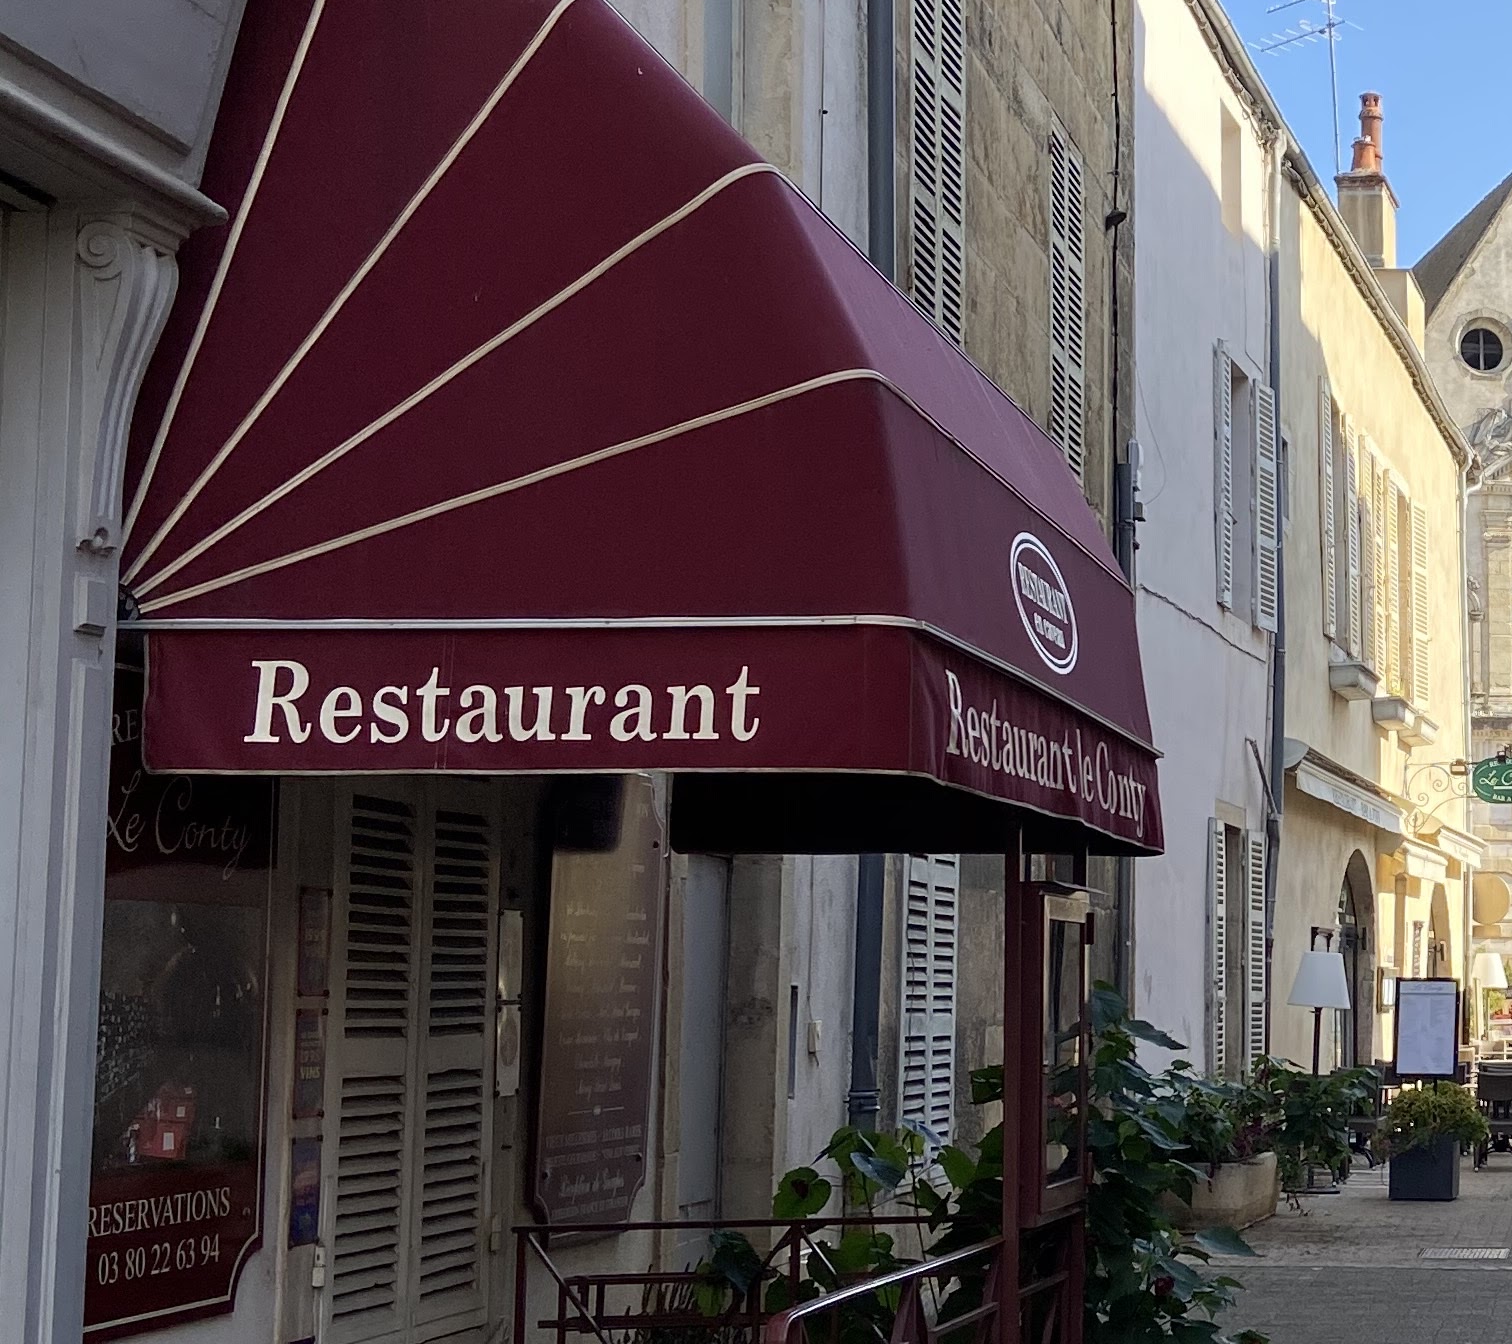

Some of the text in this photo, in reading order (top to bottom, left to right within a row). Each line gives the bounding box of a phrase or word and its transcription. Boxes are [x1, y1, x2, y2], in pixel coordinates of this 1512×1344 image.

[1018, 562, 1068, 624] RESTAURANT
[243, 659, 761, 745] Restaurant
[945, 669, 1076, 793] Restaurant
[1096, 741, 1146, 838] Conty
[107, 769, 251, 880] Le Conty
[88, 1187, 230, 1237] RESERVATIONS
[98, 1233, 220, 1285] 03 80 22 63 94
